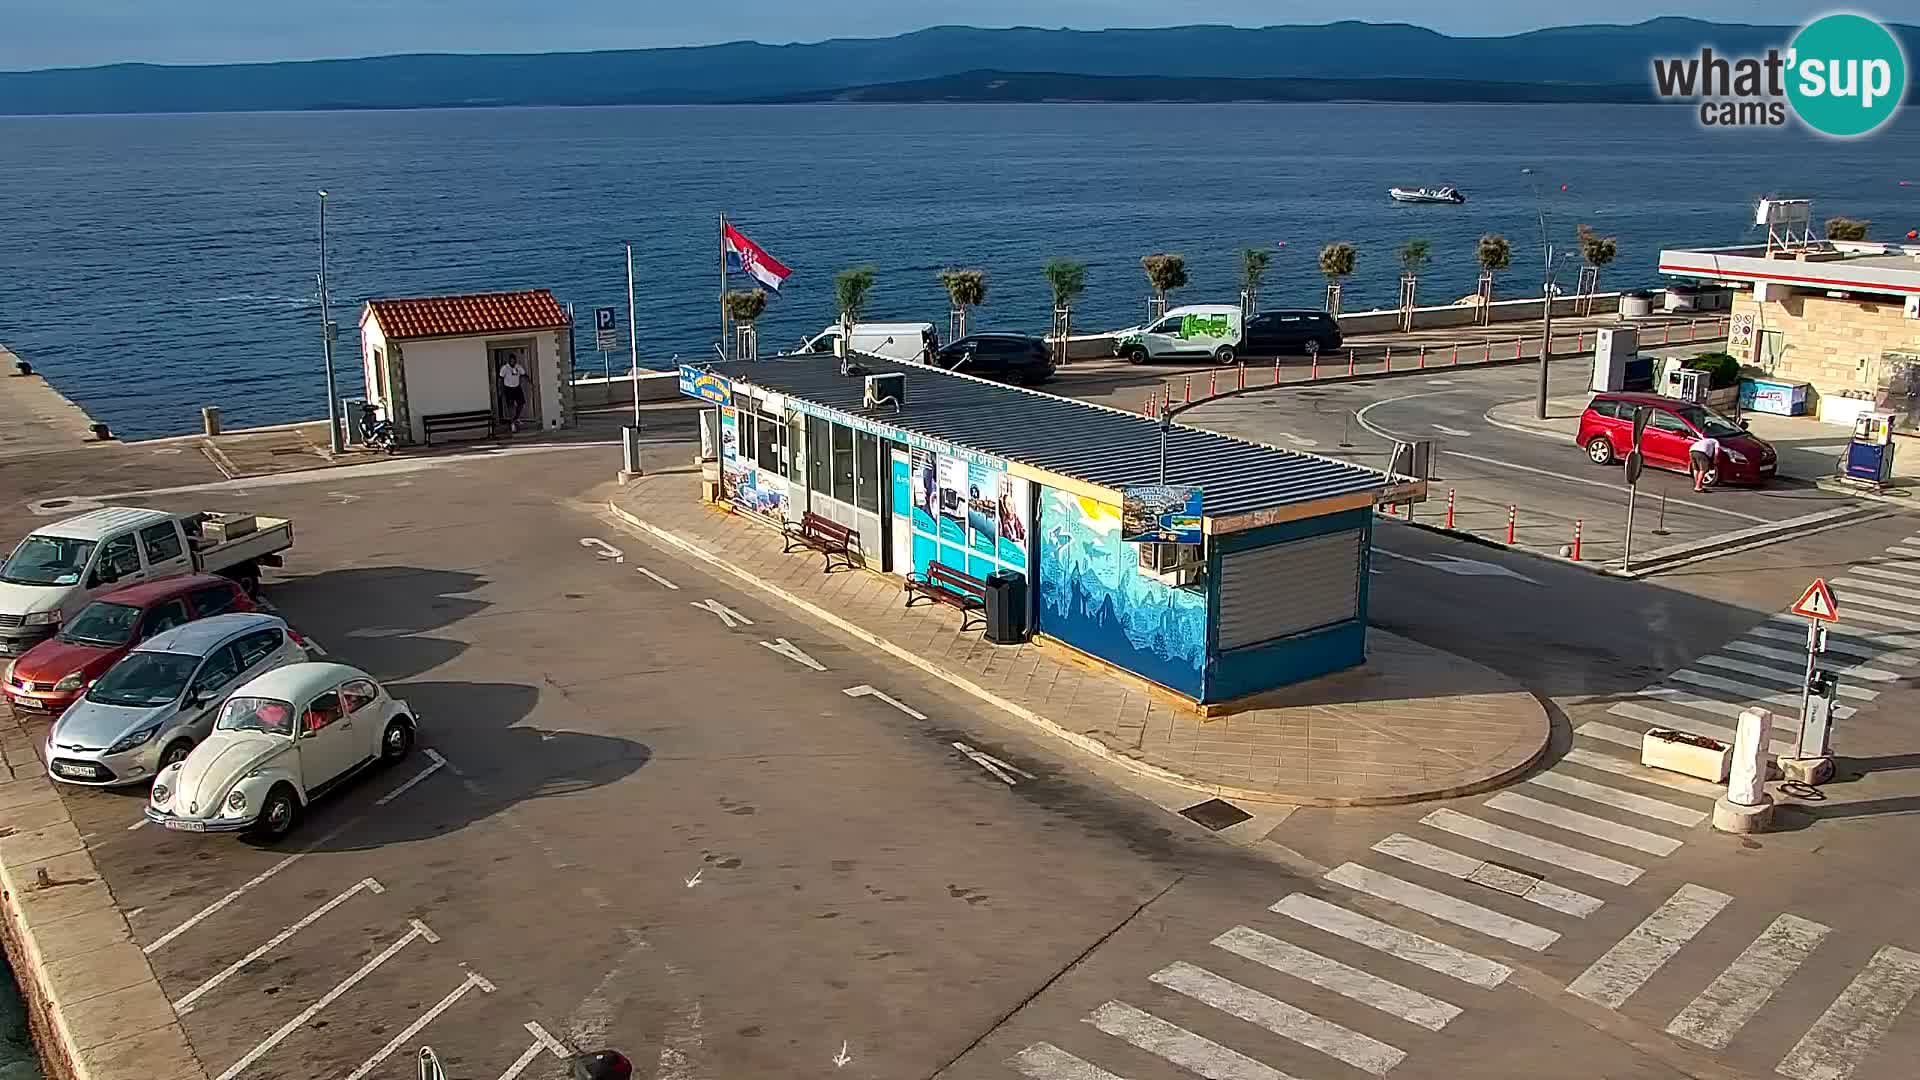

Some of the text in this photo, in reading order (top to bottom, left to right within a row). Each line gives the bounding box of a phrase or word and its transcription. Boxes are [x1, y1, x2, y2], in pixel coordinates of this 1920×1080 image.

[600, 310, 611, 327] P
[920, 438, 951, 455] STATION
[953, 446, 977, 461] TICKET
[978, 453, 1003, 469] OFFICE
